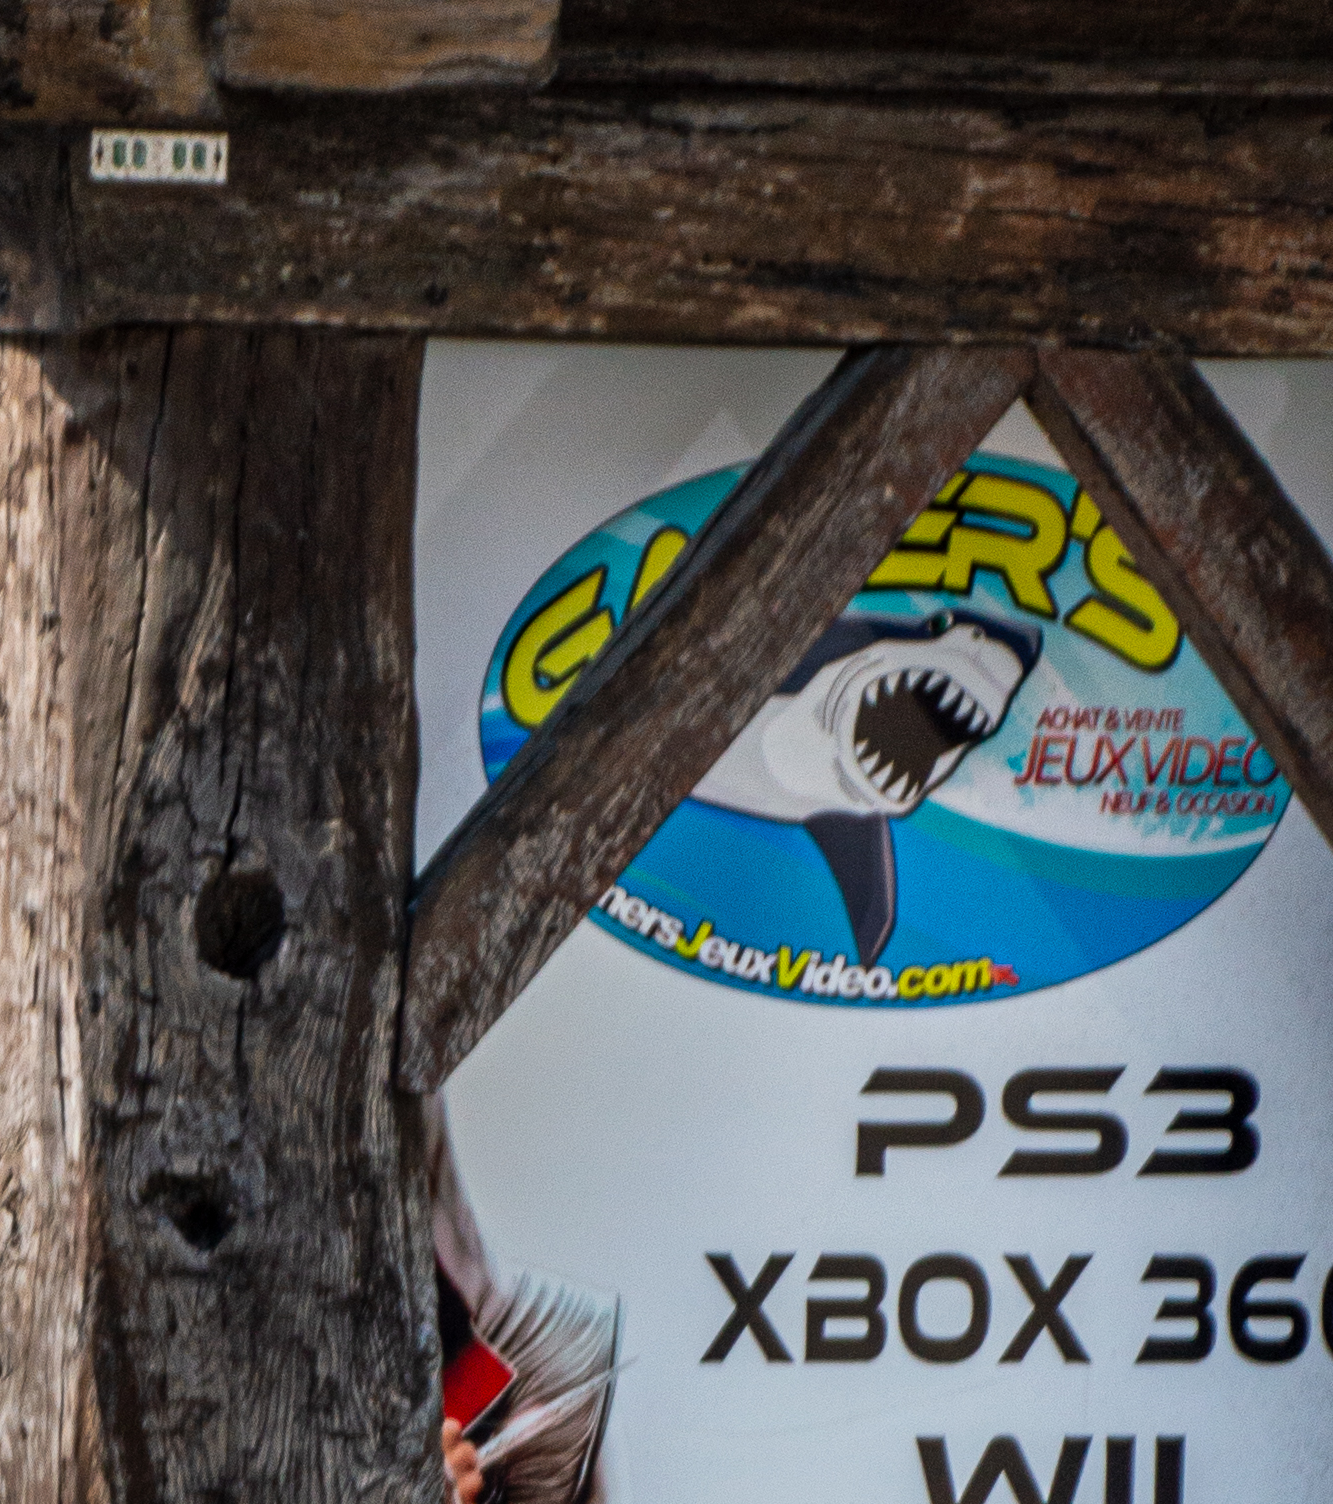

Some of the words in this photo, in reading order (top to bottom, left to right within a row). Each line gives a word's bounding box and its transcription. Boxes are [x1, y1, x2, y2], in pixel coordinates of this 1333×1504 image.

[1036, 706, 1103, 730] ACHAT
[1105, 706, 1119, 731] &
[1124, 707, 1183, 731] VENTE
[1013, 734, 1135, 786] JEUX
[1142, 735, 1279, 787] VIDEO
[1100, 792, 1149, 815] NEUF
[1155, 792, 1169, 815] &
[1177, 792, 1276, 816] OCCASION
[855, 1065, 1261, 1178] PS3
[699, 1252, 1095, 1364] XBOX
[1134, 1252, 1333, 1364] 36
